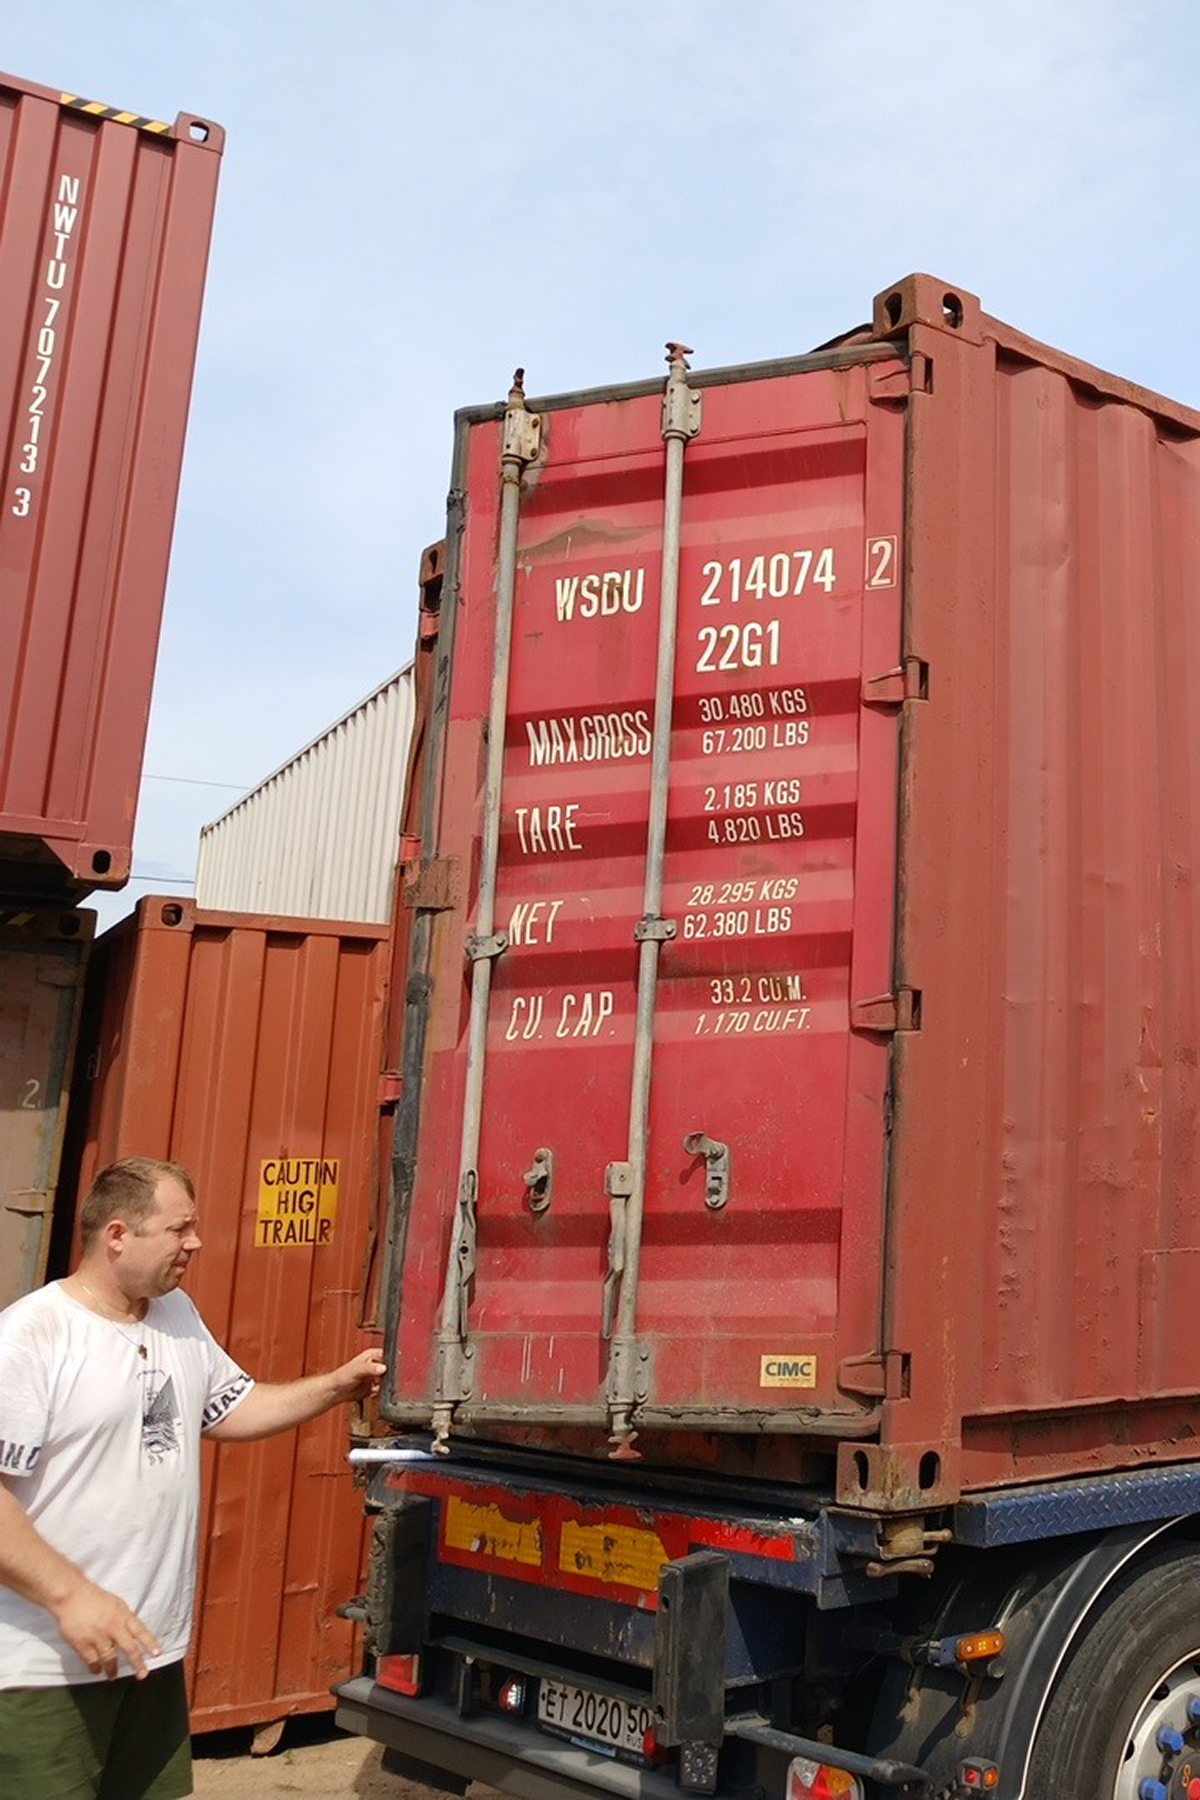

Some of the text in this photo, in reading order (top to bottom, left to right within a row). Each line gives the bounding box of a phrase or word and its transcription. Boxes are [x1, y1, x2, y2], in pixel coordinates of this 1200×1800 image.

[12, 175, 79, 516] NWTU 707213 3
[555, 540, 892, 621] WSDU 214074 2
[696, 620, 780, 673] 22G1
[768, 688, 807, 715] KGS
[773, 721, 809, 749] LBS
[515, 803, 583, 854] TARE
[763, 779, 800, 806] KGS
[766, 812, 804, 840] LBS
[508, 900, 564, 947] NET
[759, 877, 800, 901] KGS
[754, 907, 792, 935] LBS
[709, 978, 753, 1004] 33.2
[22, 1078, 40, 1108] 2
[263, 1161, 338, 1186] CAUTIN
[260, 1218, 331, 1244] TRAILR
[765, 1362, 812, 1377] CIMC
[572, 1689, 622, 1739] 2020
[627, 1705, 650, 1737] 50
[626, 1734, 643, 1749] RUS
